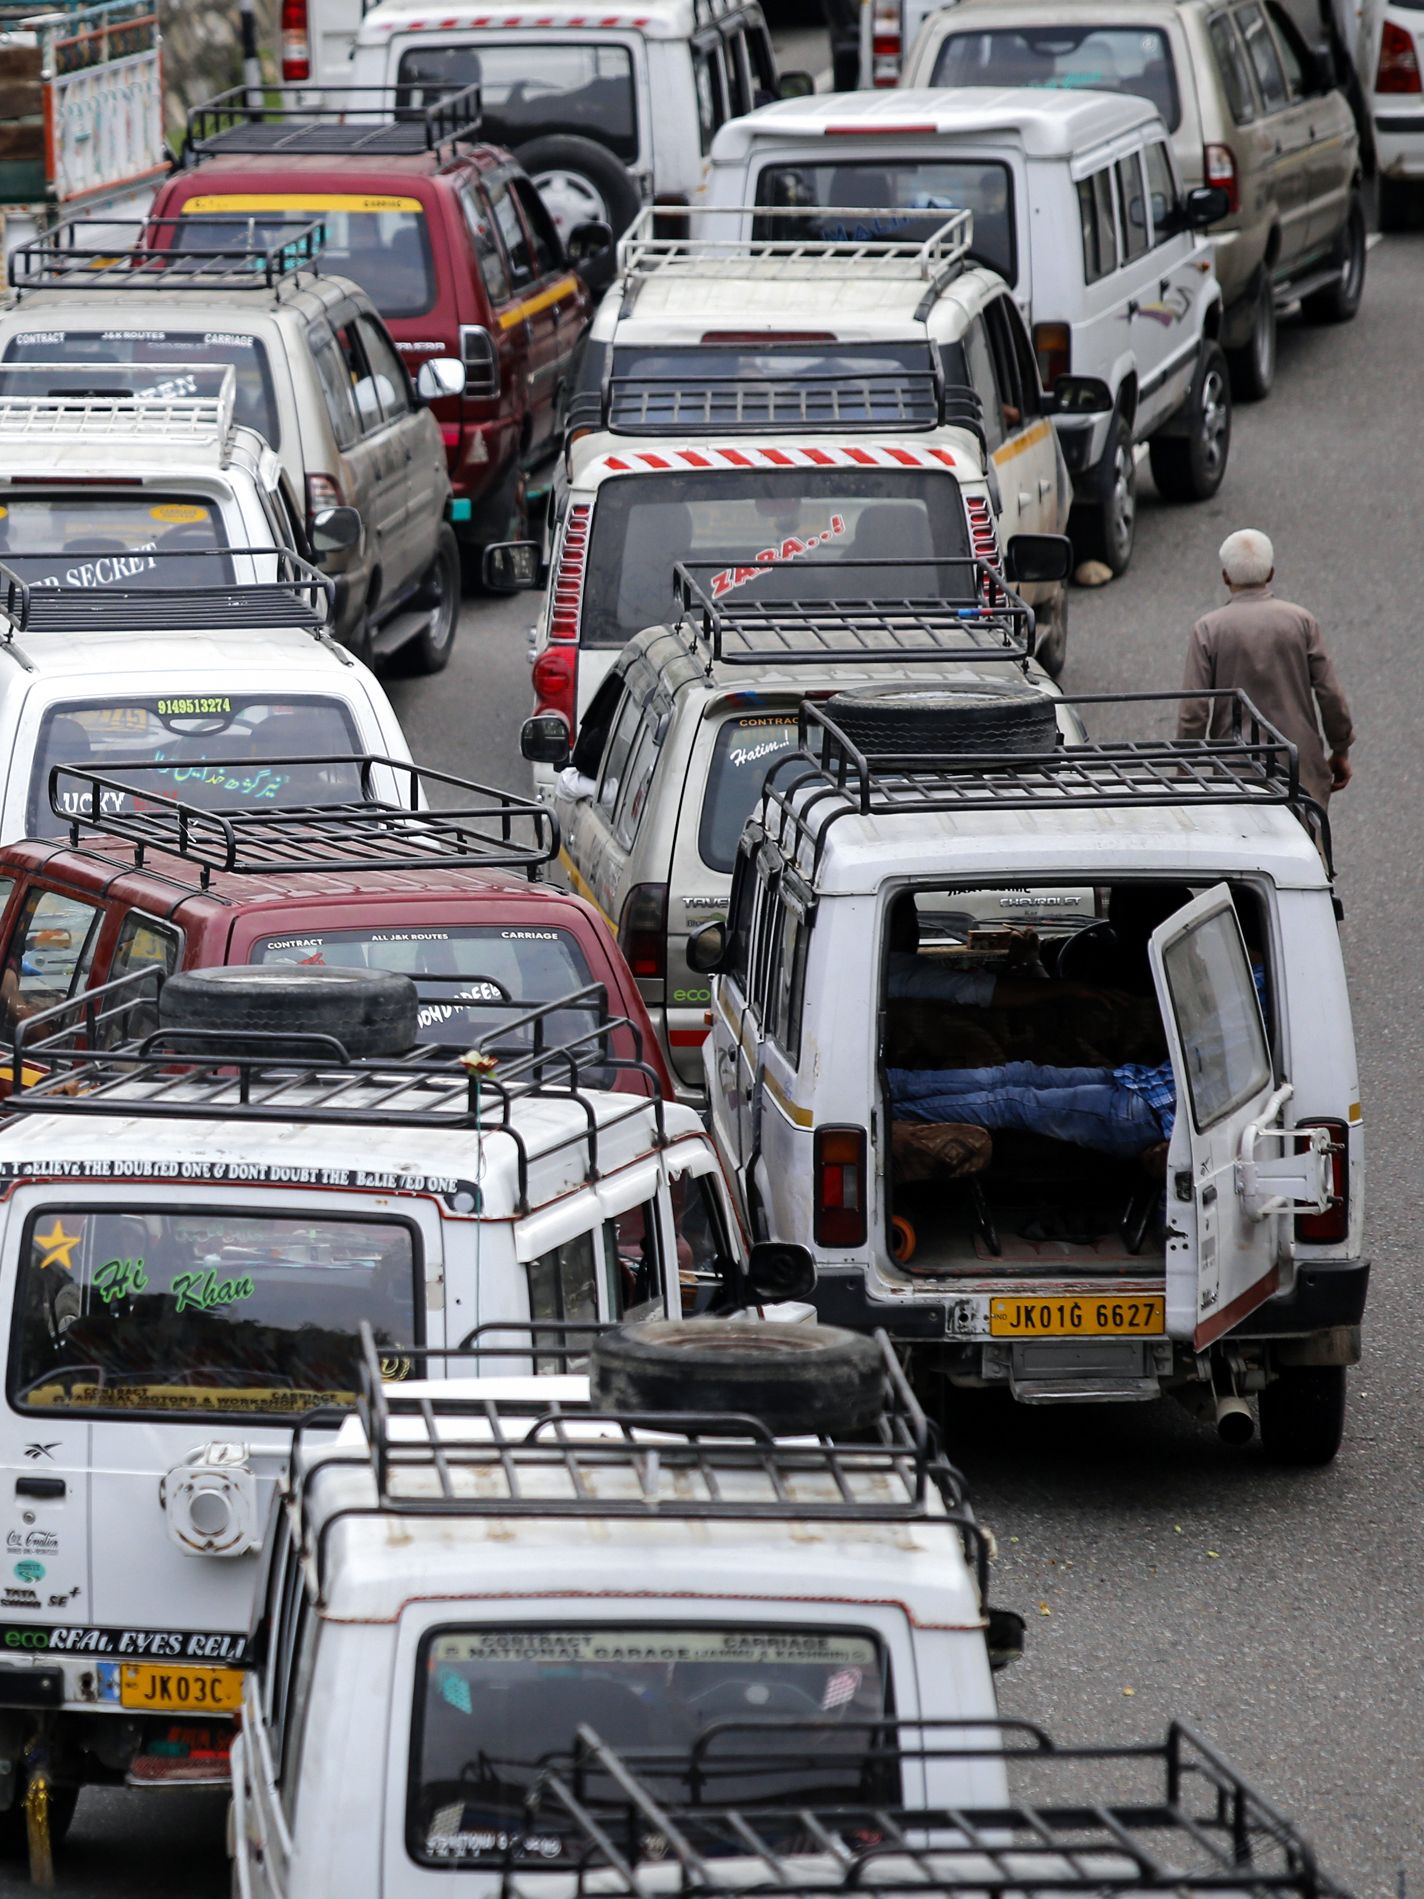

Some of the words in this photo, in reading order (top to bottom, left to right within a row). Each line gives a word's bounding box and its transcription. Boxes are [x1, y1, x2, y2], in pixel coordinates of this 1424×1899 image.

[16, 332, 65, 345] CONTRACT
[125, 331, 166, 340] ROUTES
[204, 333, 253, 346] CARRIAGE
[157, 698, 231, 714] 9149513274
[739, 717, 800, 727] CONTRAC
[999, 896, 1081, 908] CHEVROLET
[267, 938, 324, 950] CONTRACT
[410, 933, 449, 941] ROUTES
[500, 931, 559, 940] CARRIAGE
[673, 989, 710, 1001] eco
[84, 1160, 111, 1175] THE
[181, 1162, 211, 1177] ONE
[213, 1162, 225, 1179] &
[228, 1164, 268, 1180] DONT
[270, 1165, 318, 1182] DOUBT
[321, 1167, 350, 1185] THE
[427, 1176, 458, 1193] ONE
[93, 1258, 147, 1302] Hi
[172, 1266, 255, 1312] Khan
[1010, 1301, 1082, 1329] JK01G
[1096, 1302, 1155, 1328] 6627
[119, 1631, 183, 1656] EYES
